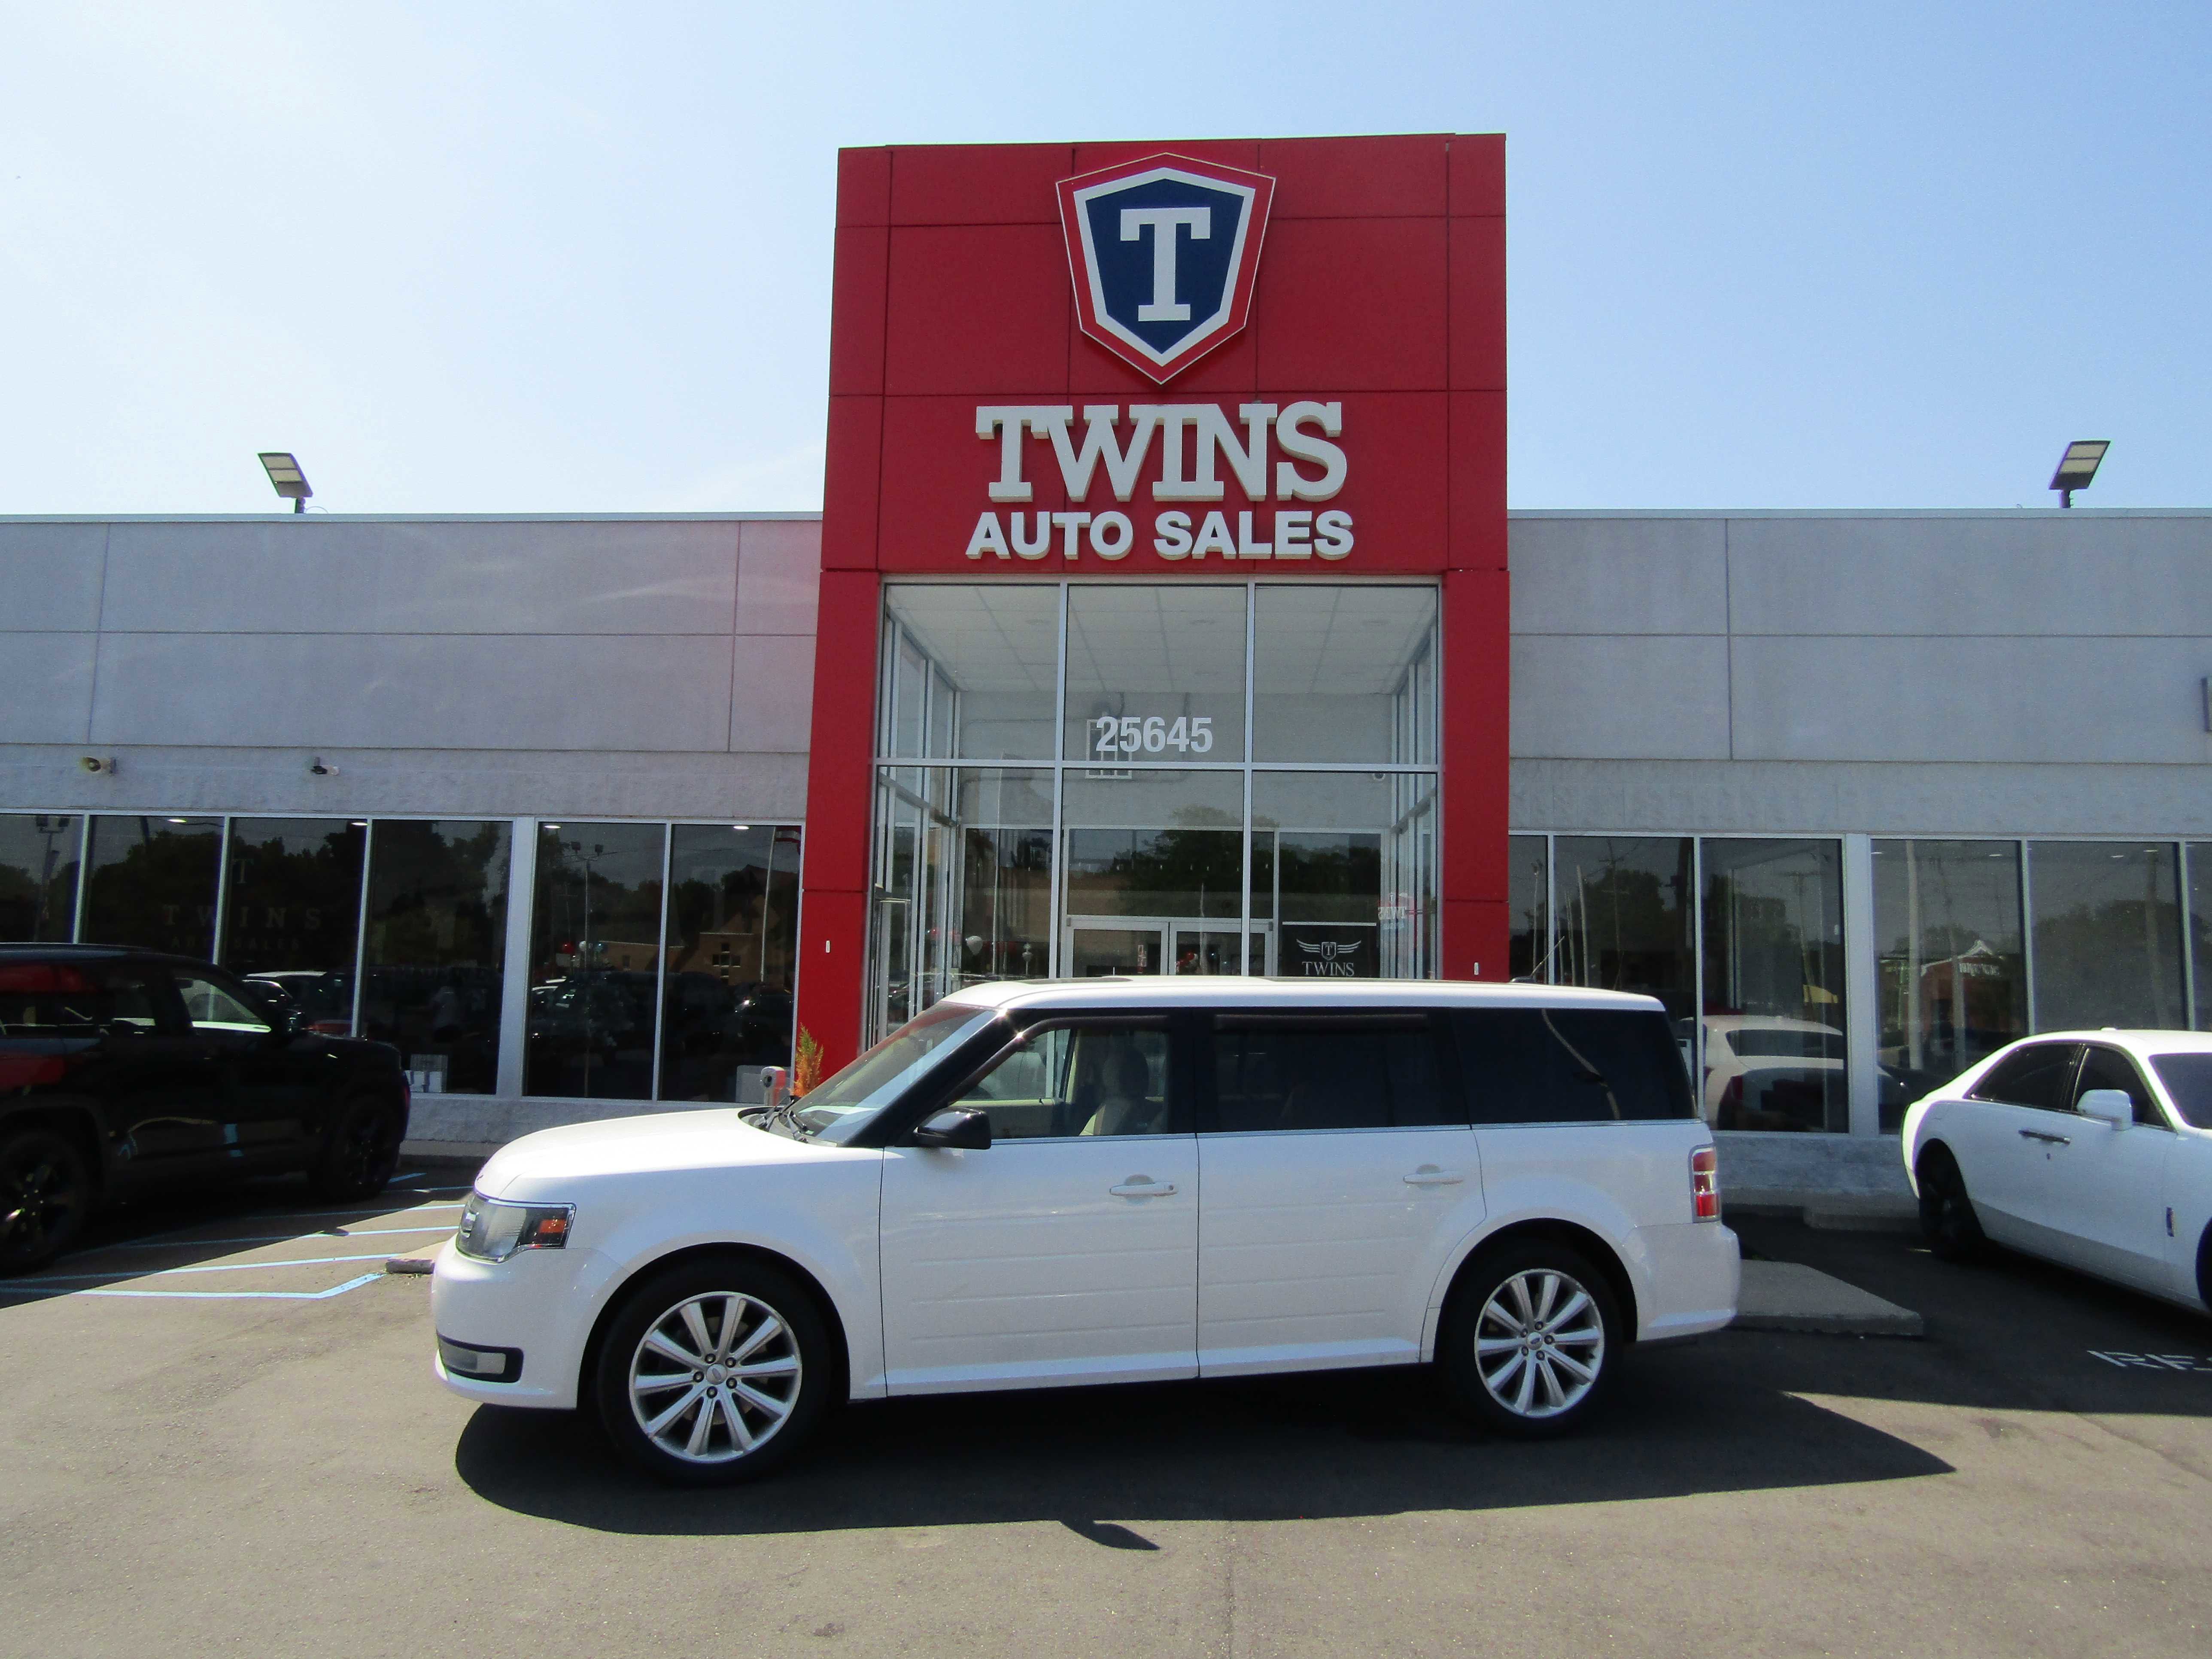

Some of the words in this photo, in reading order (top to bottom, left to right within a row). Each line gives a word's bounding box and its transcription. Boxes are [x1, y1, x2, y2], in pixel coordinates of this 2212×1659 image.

[1120, 207, 1211, 322] T
[975, 401, 1347, 503] TWINS
[965, 511, 1134, 560] AUTO
[1153, 510, 1355, 560] SALES
[1096, 716, 1212, 752] 25645
[1302, 962, 1355, 977] TWINS
[1325, 945, 1333, 956] T
